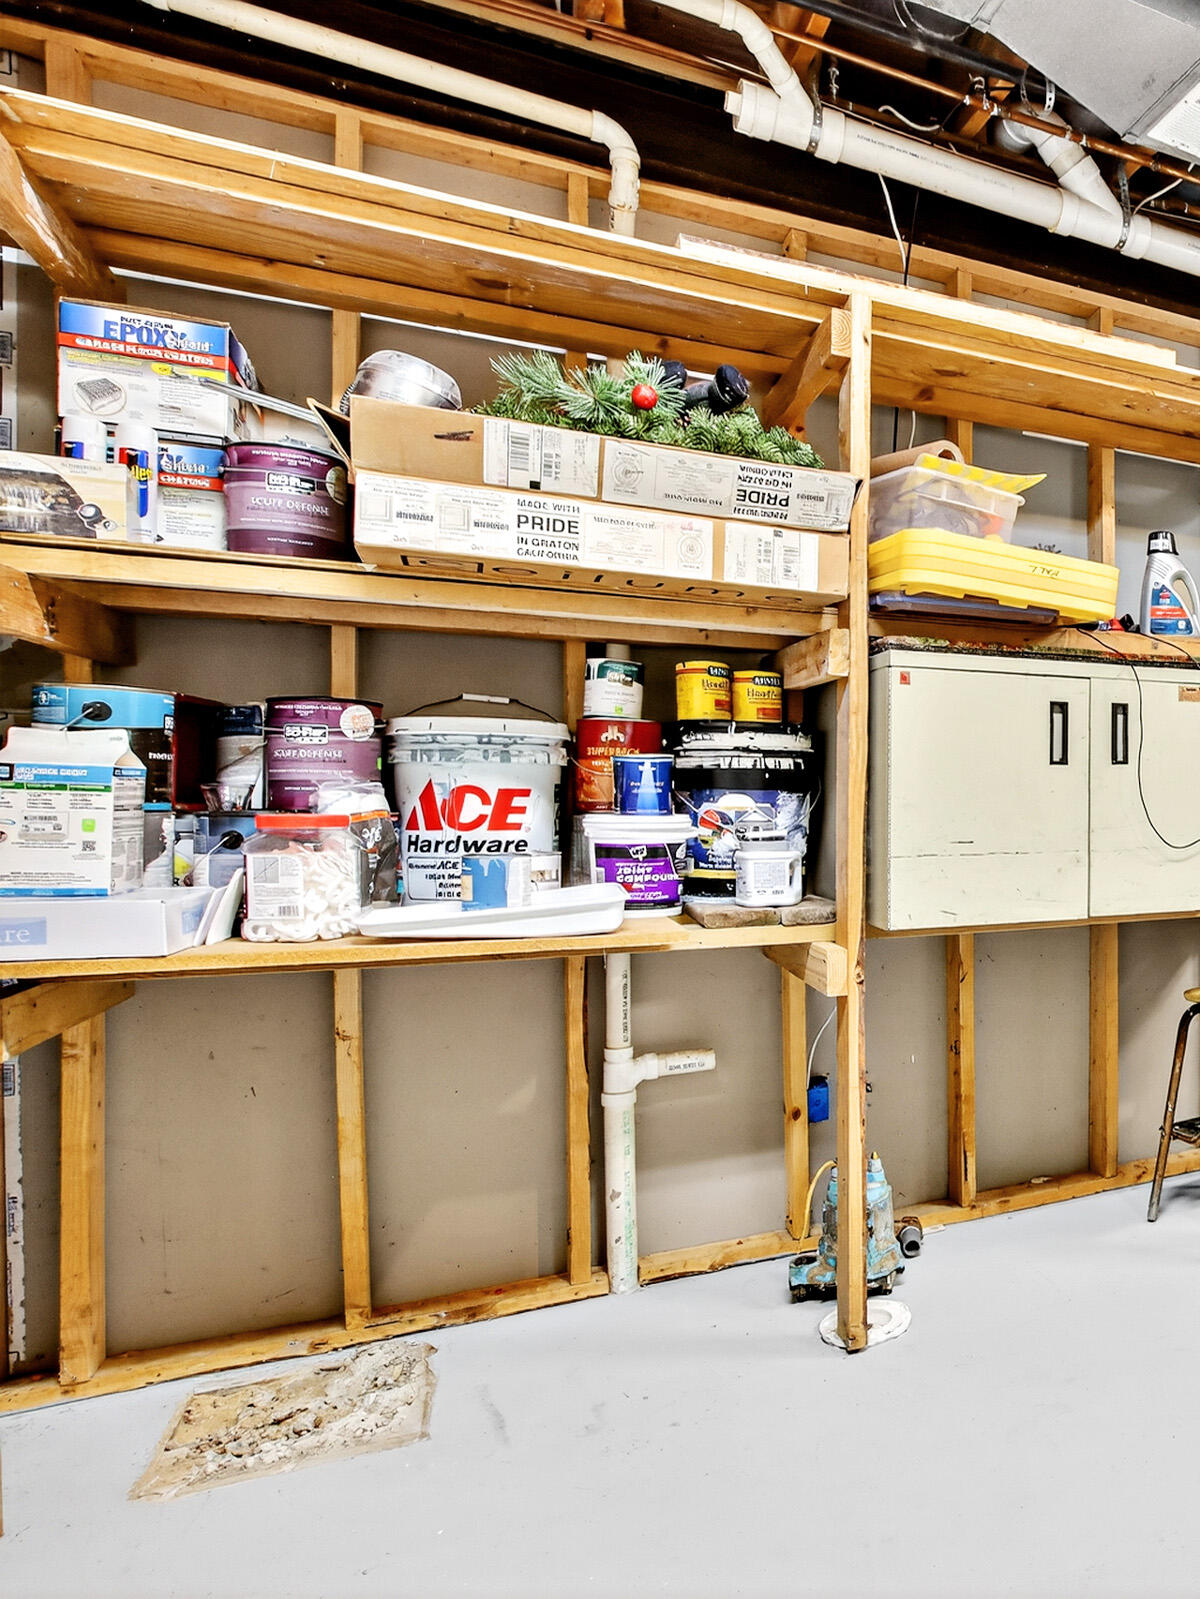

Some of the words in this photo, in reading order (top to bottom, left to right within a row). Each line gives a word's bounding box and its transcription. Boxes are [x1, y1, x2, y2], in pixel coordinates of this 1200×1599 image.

[735, 488, 790, 507] PRIDE
[552, 503, 580, 513] WITH
[517, 514, 580, 535] PRIDE
[517, 536, 528, 545] IN
[405, 777, 532, 832] ACE
[407, 835, 529, 853] Hardware
